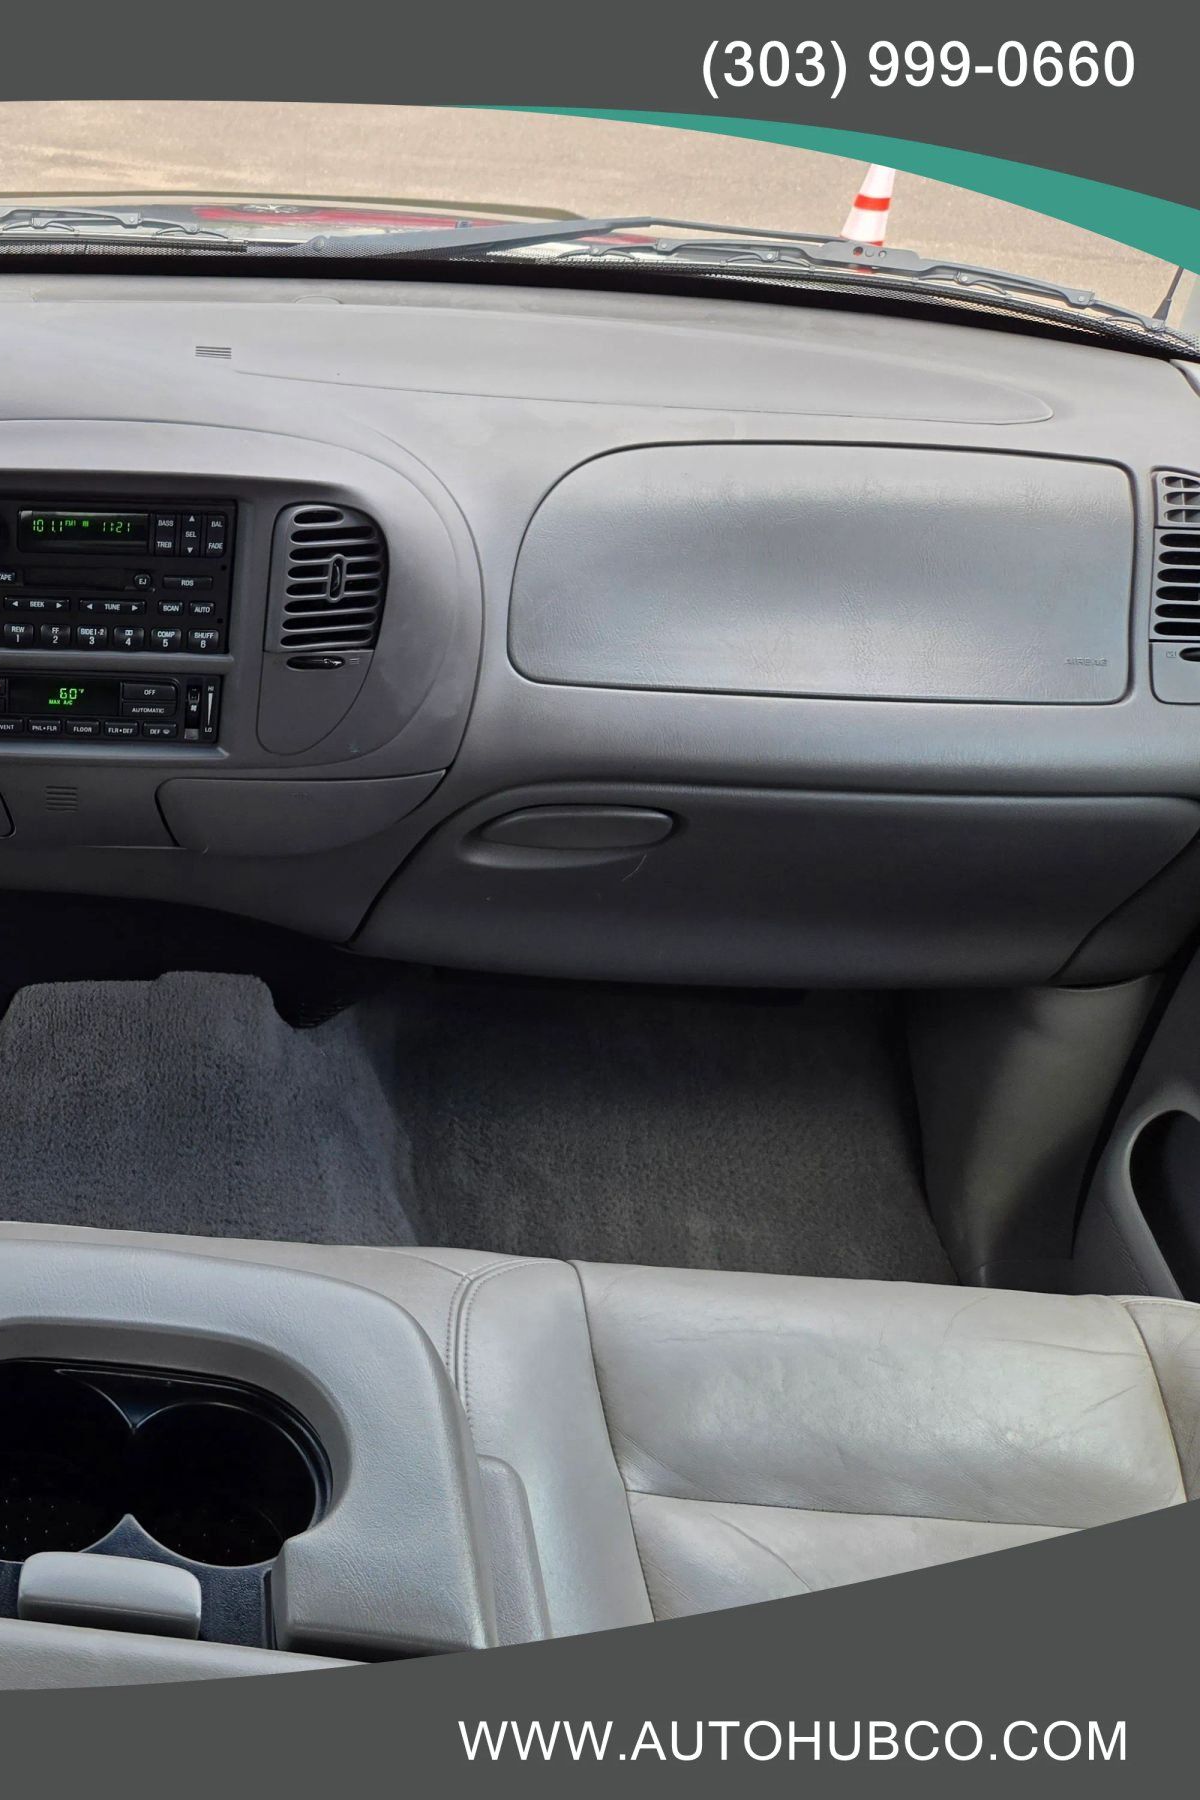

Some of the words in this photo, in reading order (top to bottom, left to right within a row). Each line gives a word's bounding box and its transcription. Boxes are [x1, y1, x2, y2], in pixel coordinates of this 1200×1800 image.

[208, 542, 223, 550] FADE
[194, 605, 210, 613] AUTO
[157, 630, 175, 638] COMP
[52, 635, 58, 644] 2
[89, 636, 95, 645] 3
[125, 637, 131, 646] 4
[163, 638, 169, 647] 5
